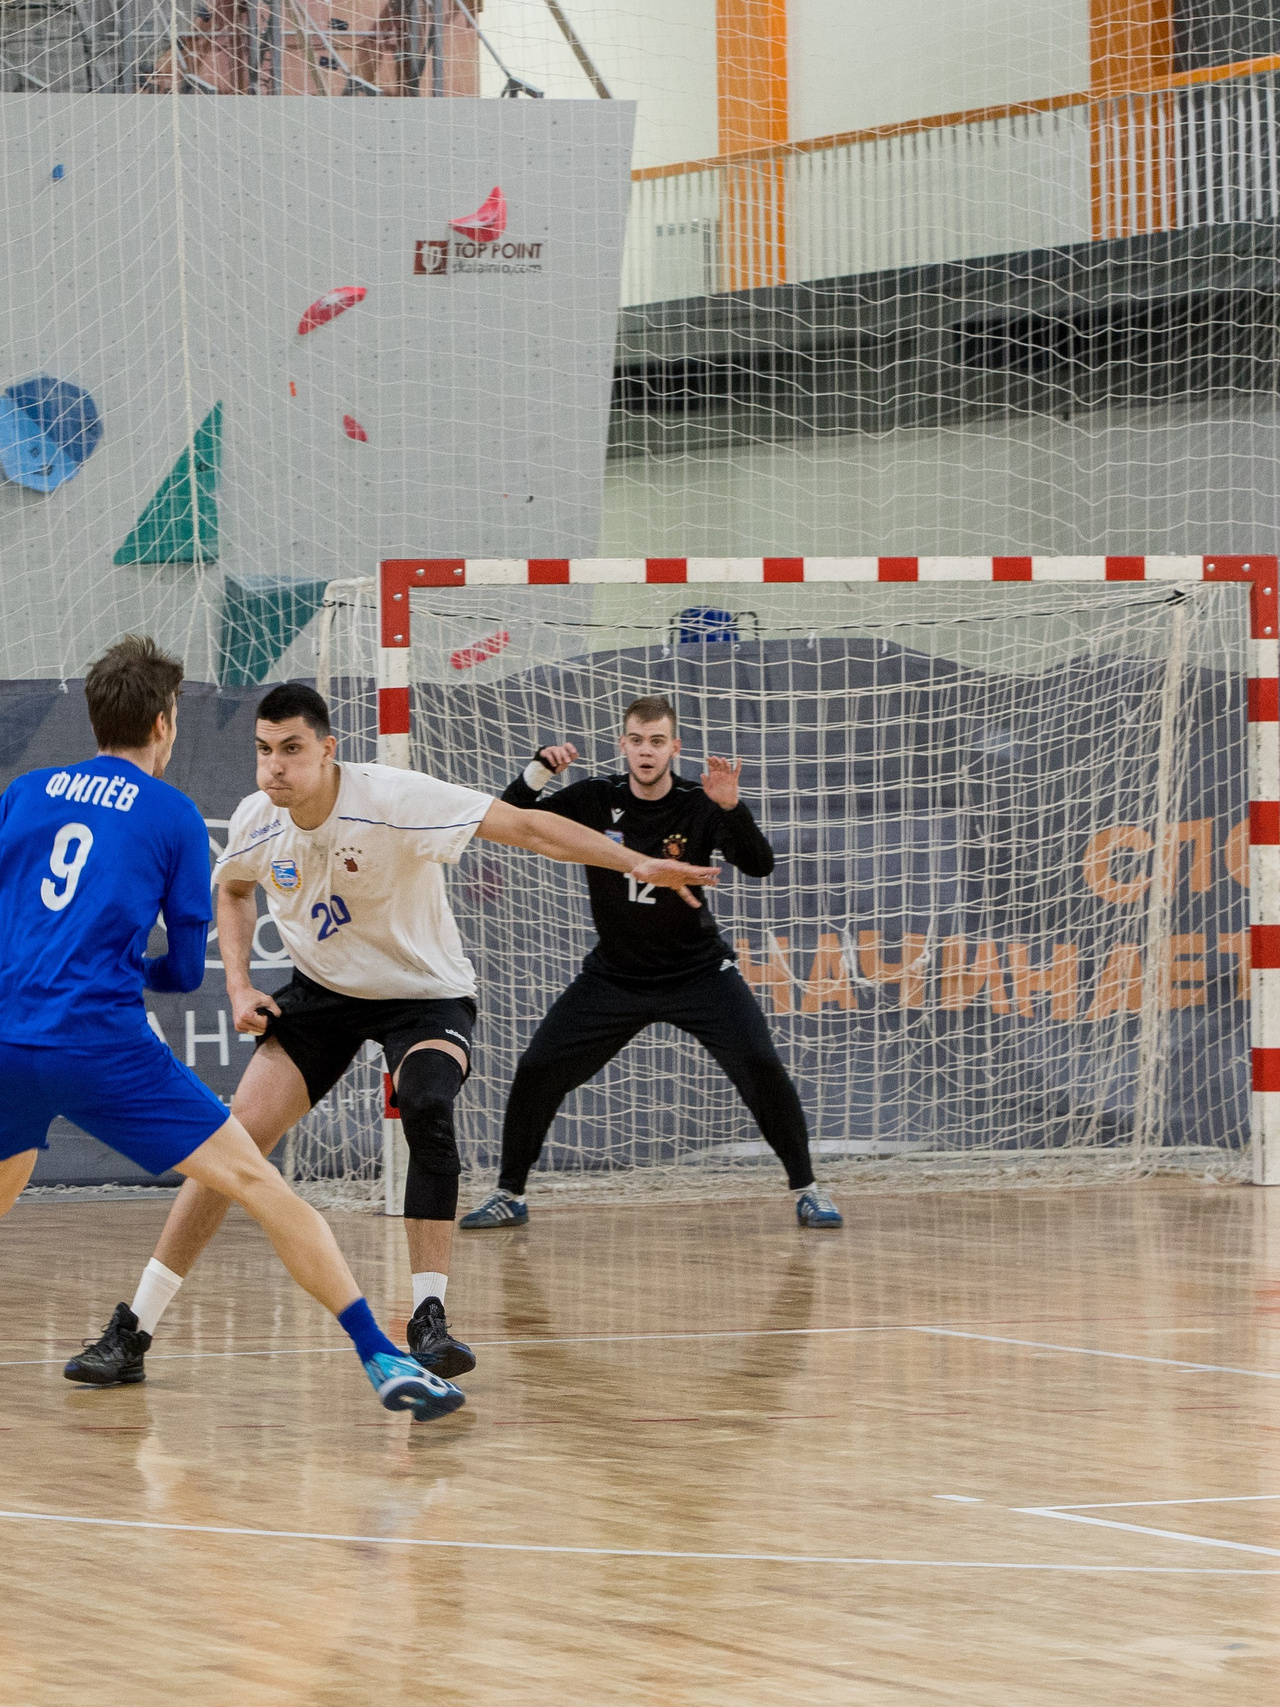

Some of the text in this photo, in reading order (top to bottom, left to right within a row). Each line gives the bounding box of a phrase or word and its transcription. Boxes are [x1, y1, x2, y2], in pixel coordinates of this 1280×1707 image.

[453, 242, 543, 259] TOP POINT
[40, 822, 94, 912] 9
[624, 872, 656, 904] 12
[311, 894, 352, 941] 20
